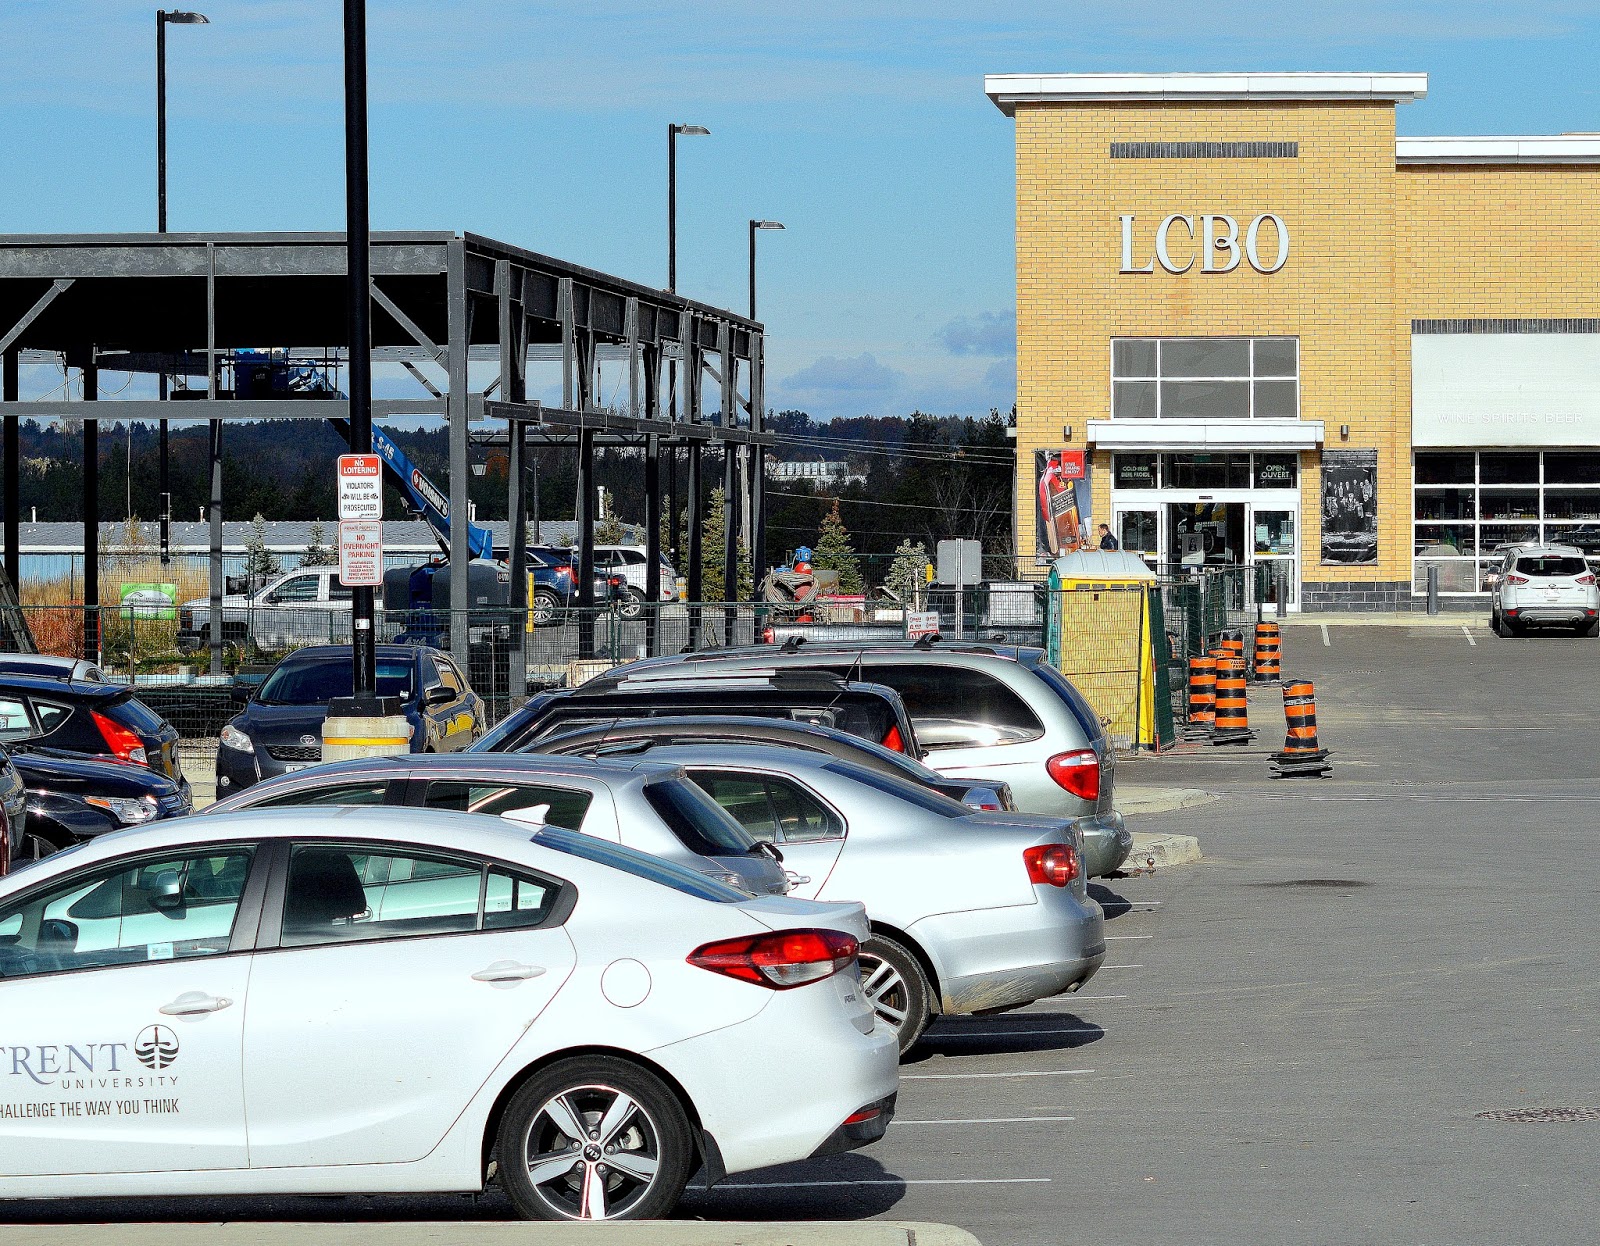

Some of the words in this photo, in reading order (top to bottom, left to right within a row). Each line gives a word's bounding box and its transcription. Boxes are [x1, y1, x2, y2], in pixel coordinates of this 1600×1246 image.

[1118, 213, 1290, 275] LCBO
[1438, 412, 1475, 424] WINE
[1481, 412, 1538, 424] SPIRITS
[1544, 411, 1584, 424] BEER
[354, 459, 365, 467] NO
[343, 466, 377, 474] LOITERING
[1260, 471, 1291, 479] OUVERT
[345, 482, 374, 490] VIOLATORS
[350, 493, 362, 501] WILL
[363, 493, 370, 501] BE
[343, 503, 377, 512] PROSECUTED
[343, 542, 379, 550] OVERNIGHT
[347, 550, 375, 558] PARKING
[62, 1076, 179, 1089] UNIVERSITY
[0, 1102, 56, 1119] HALLENGE
[60, 1101, 82, 1116] THE
[85, 1100, 112, 1116] WAY
[117, 1099, 140, 1115] YOU
[143, 1098, 180, 1114] THINK
